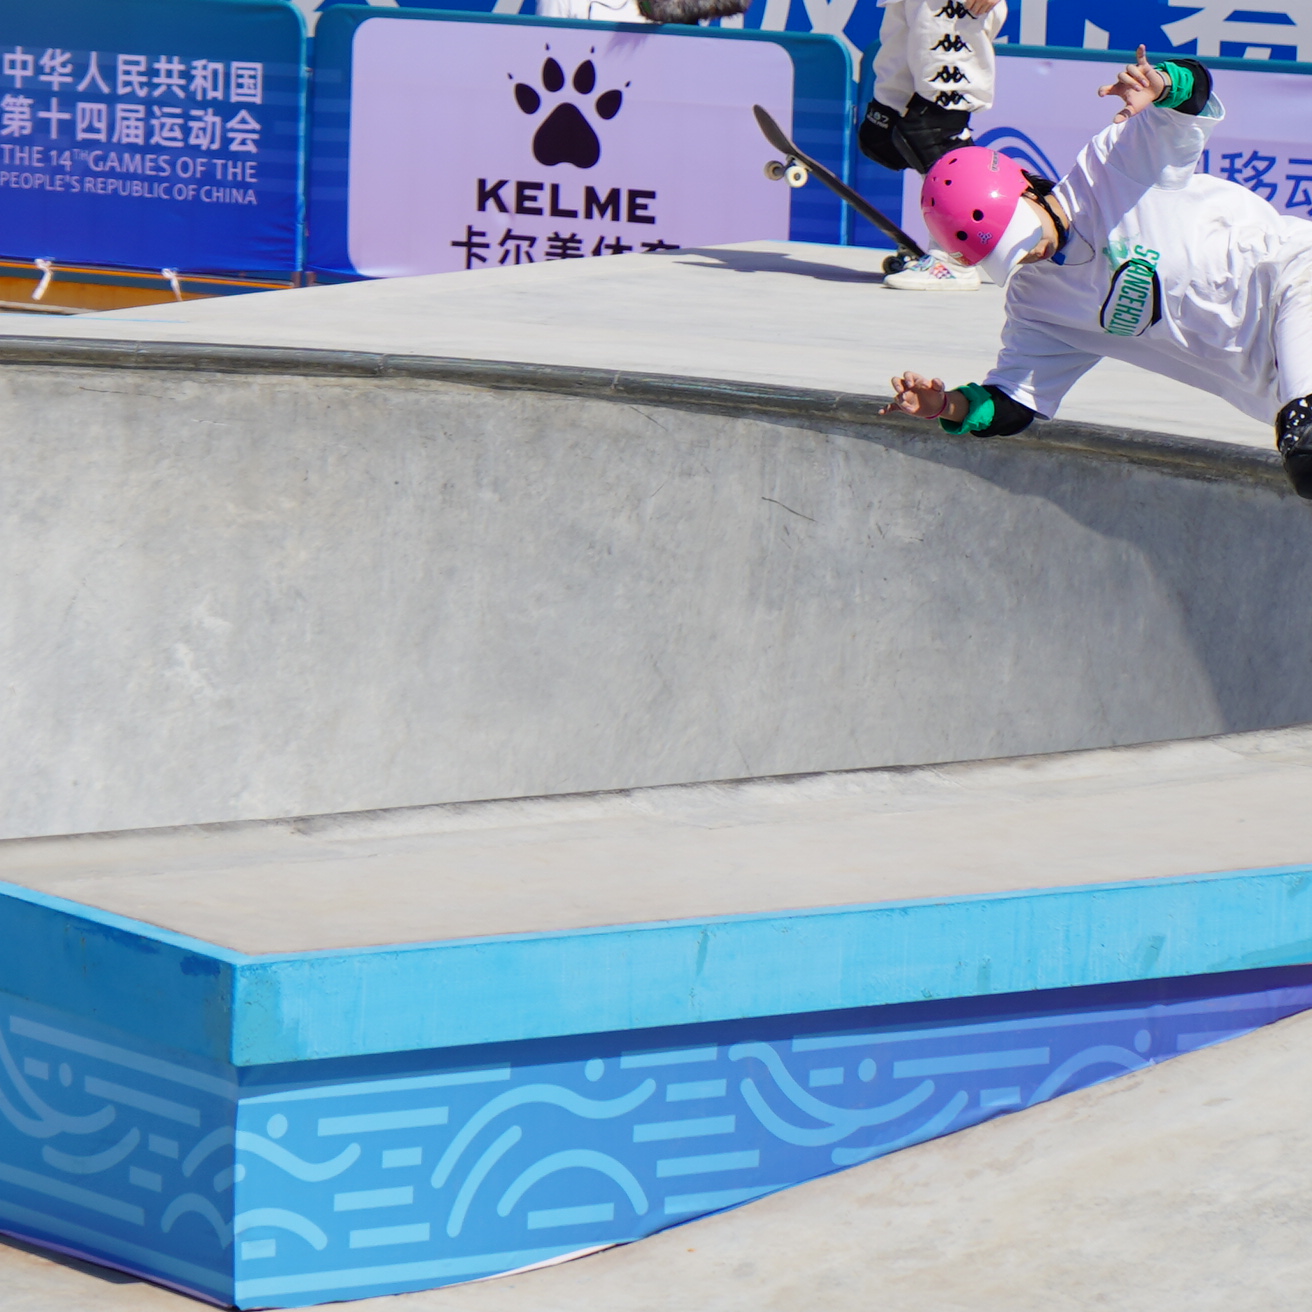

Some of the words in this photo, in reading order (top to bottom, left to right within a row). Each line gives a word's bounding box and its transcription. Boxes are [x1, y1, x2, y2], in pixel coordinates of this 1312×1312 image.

[1, 45, 264, 105] 中华人民共和国
[0, 93, 262, 155] 第十四届运动会
[0, 144, 44, 168] THE
[89, 150, 172, 177] GAMES
[175, 157, 208, 180] OF
[209, 159, 259, 184] THE
[83, 176, 170, 200] REPUBLIC
[173, 181, 198, 202] OF
[199, 183, 258, 206] CHINA
[476, 177, 657, 225] KELME
